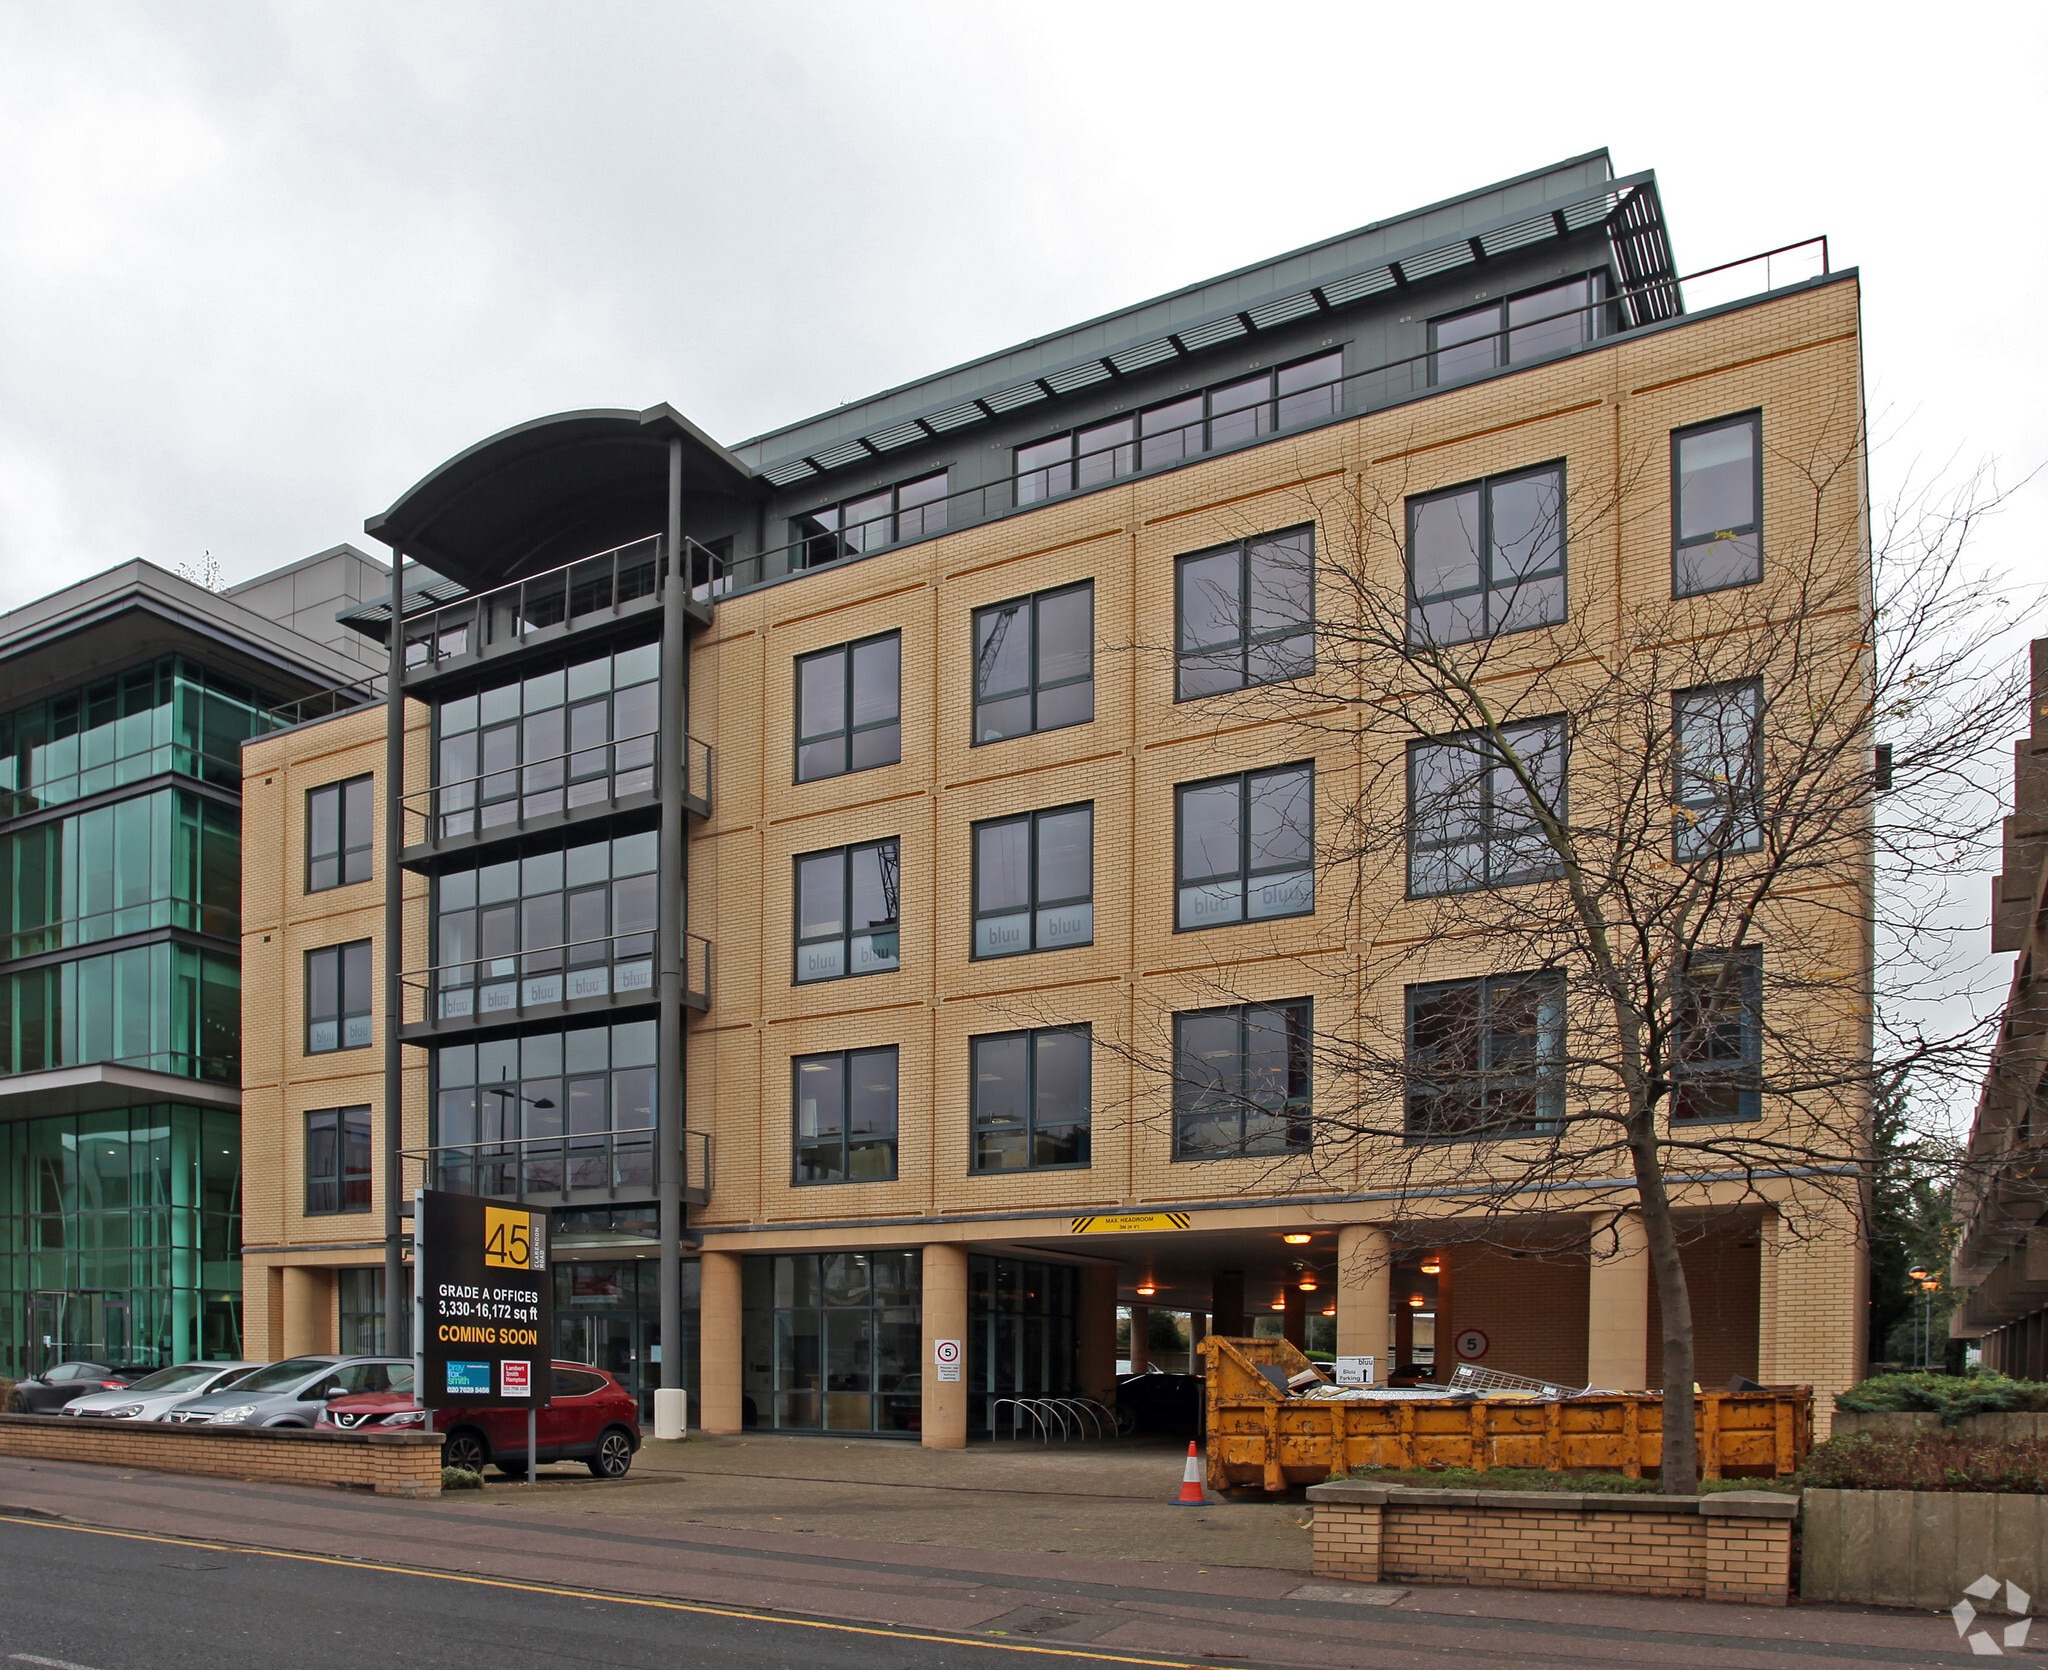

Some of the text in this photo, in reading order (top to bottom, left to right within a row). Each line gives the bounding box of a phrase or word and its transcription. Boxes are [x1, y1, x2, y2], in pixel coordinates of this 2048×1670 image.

[1194, 896, 1229, 915] bluu
[1050, 917, 1080, 936] bluu
[989, 927, 1019, 945] bluu
[809, 954, 836, 971] bluu
[861, 946, 889, 963] bluu
[576, 979, 599, 995] bluu
[623, 971, 647, 987] bluu
[488, 993, 509, 1008] bluu
[531, 986, 553, 1001] bluu
[447, 999, 468, 1014] bluu
[317, 1029, 334, 1044] bluu
[350, 1024, 368, 1038] bluu
[485, 1224, 530, 1265] 45
[439, 1284, 538, 1303] GRADE A OFFICES
[439, 1300, 538, 1323] 3,330-16,172 sq ft
[438, 1325, 538, 1345] COMING SOON
[945, 1348, 952, 1357] 5
[1466, 1338, 1477, 1351] 5
[447, 1362, 465, 1373] bray
[447, 1376, 470, 1385] smith
